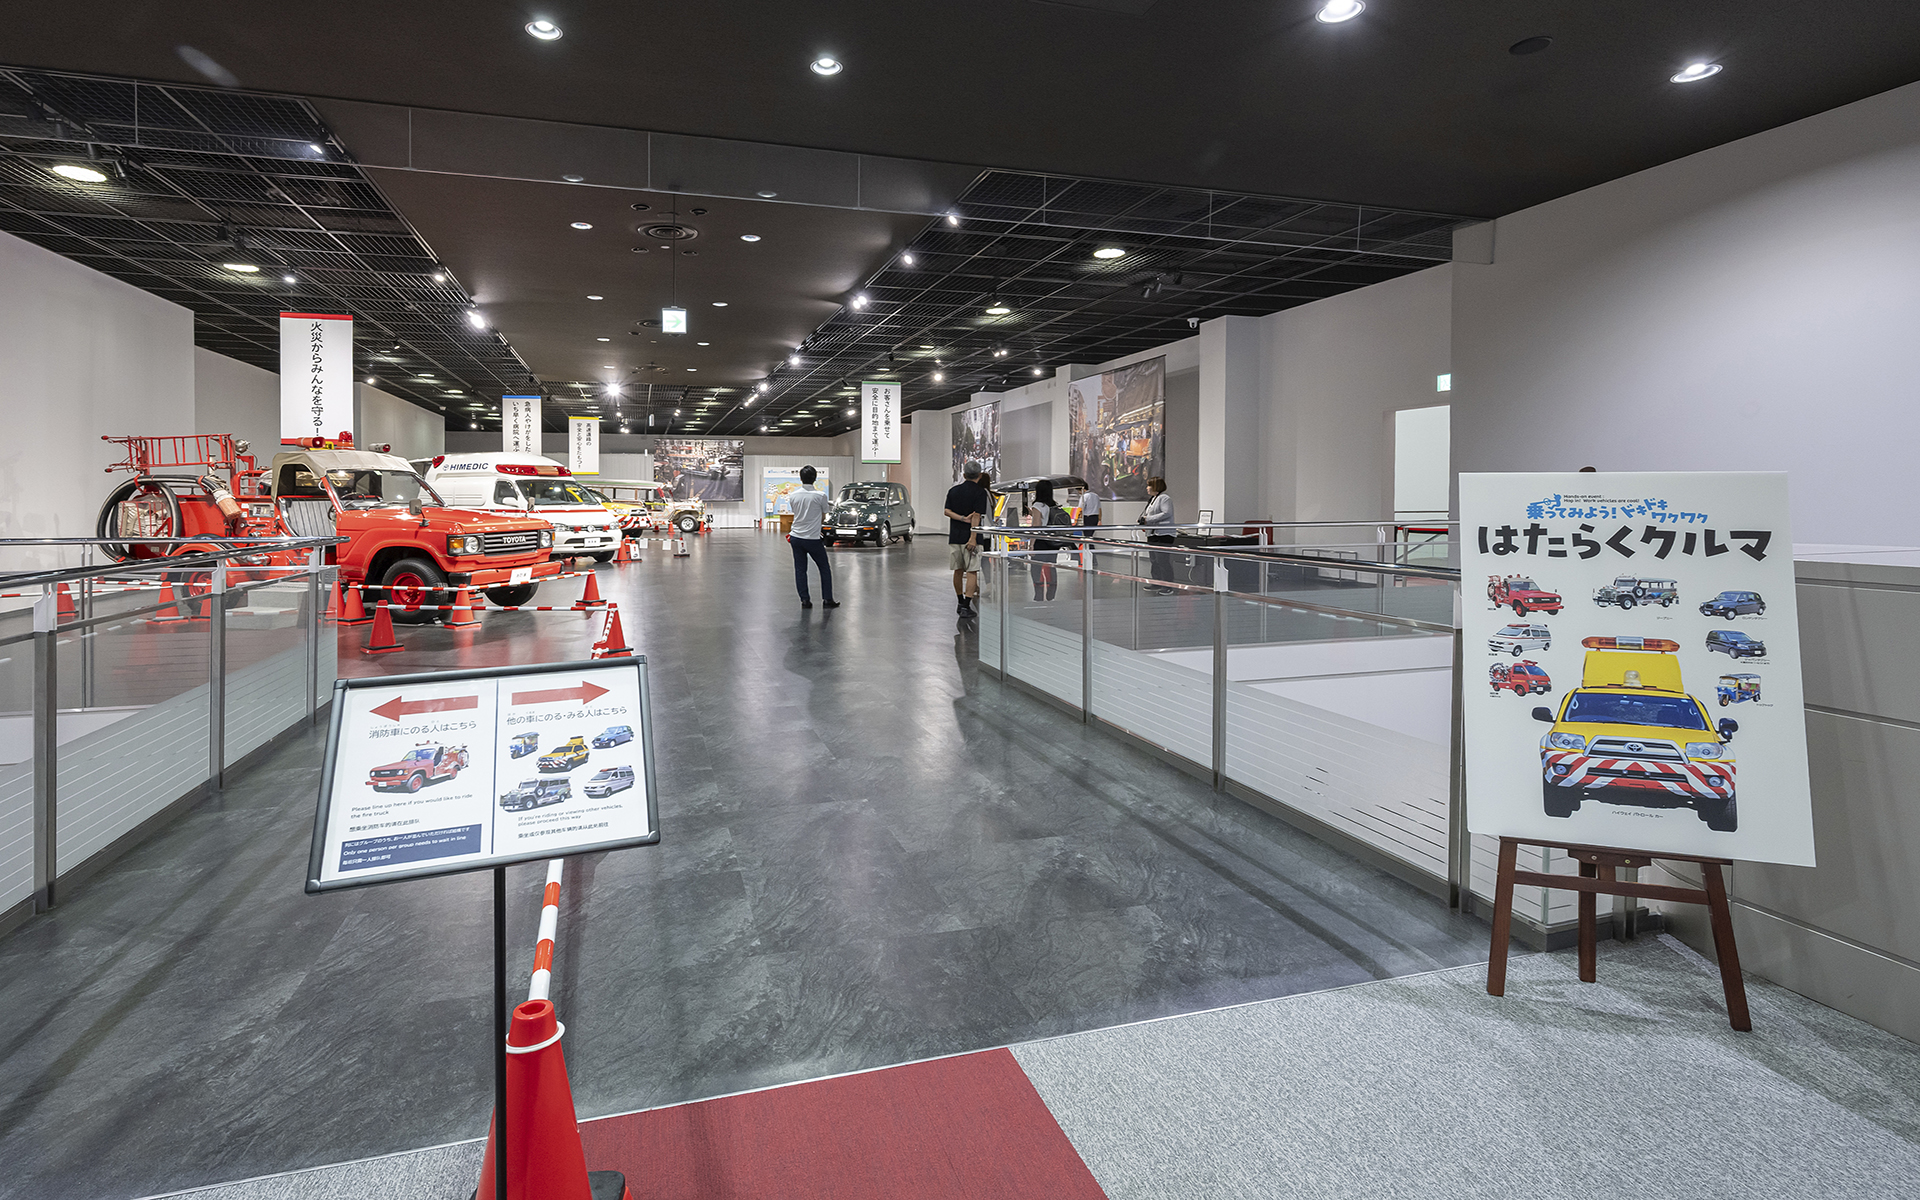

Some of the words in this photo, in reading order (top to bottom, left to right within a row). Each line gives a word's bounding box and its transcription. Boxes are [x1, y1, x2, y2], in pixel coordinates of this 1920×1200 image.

[310, 322, 324, 436] 火災からみんなを守る！
[1526, 504, 1617, 520] 乗ってみよう！
[1620, 498, 1668, 519] ドキドキ
[1651, 512, 1708, 524] ワクワク
[1478, 523, 1772, 562] はたらくクルマ
[506, 706, 628, 725] 他の車にのる・みる人はこちら
[369, 720, 477, 739] 消防車にのる人はこちら
